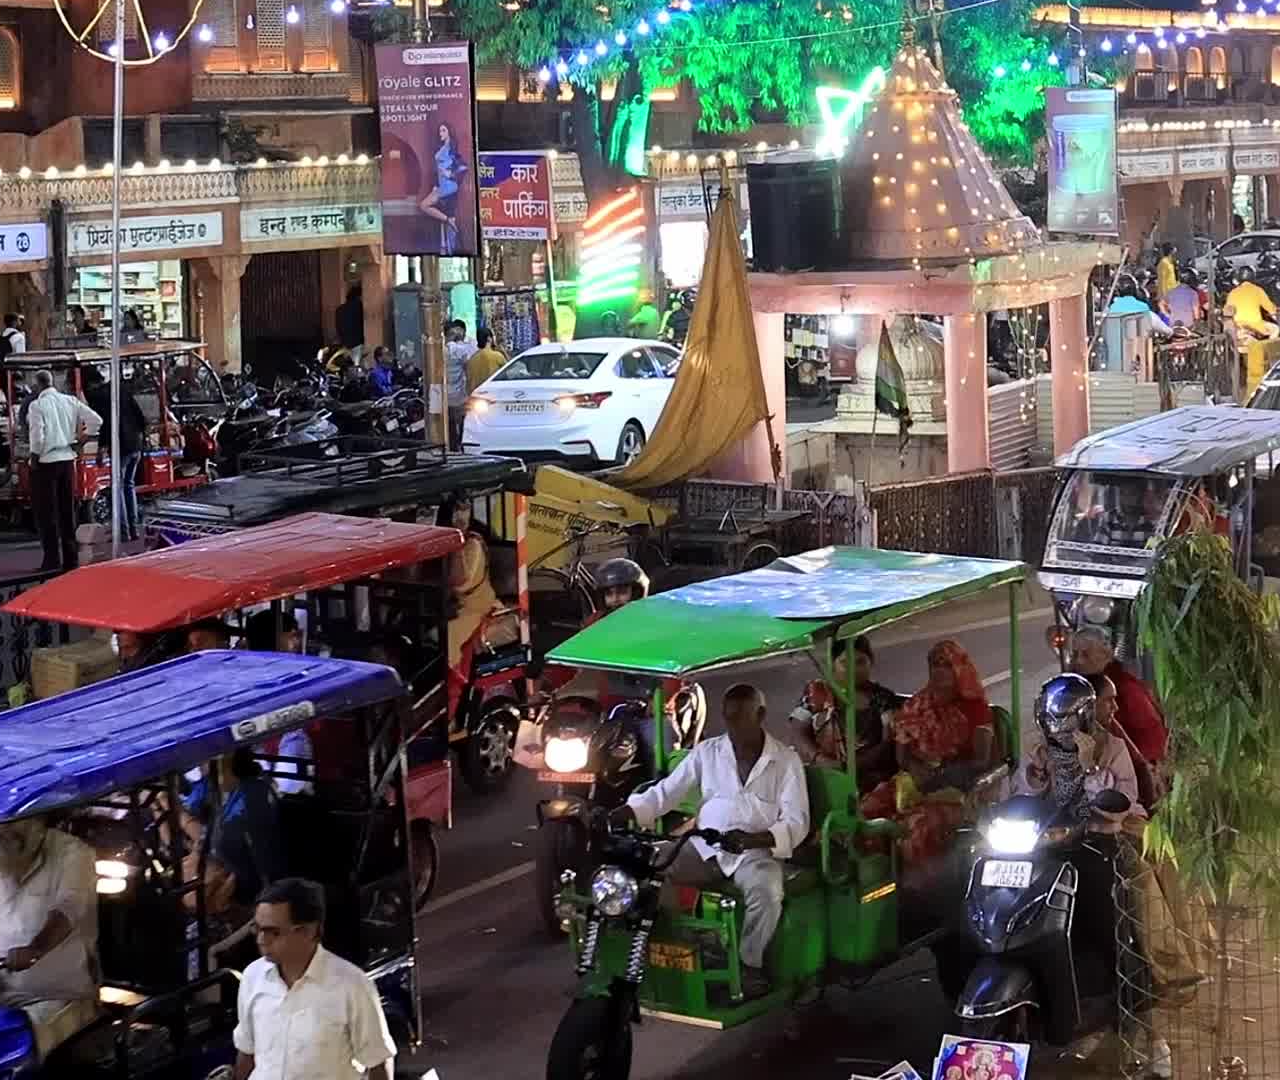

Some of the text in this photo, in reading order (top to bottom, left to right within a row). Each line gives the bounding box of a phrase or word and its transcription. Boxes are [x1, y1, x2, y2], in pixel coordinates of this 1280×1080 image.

[424, 76, 461, 87] GLITZ
[380, 103, 438, 113] STEALS YOUR
[380, 114, 427, 122] SPOTLIGHT
[510, 164, 538, 183] कार
[502, 191, 548, 219] पार्किंग
